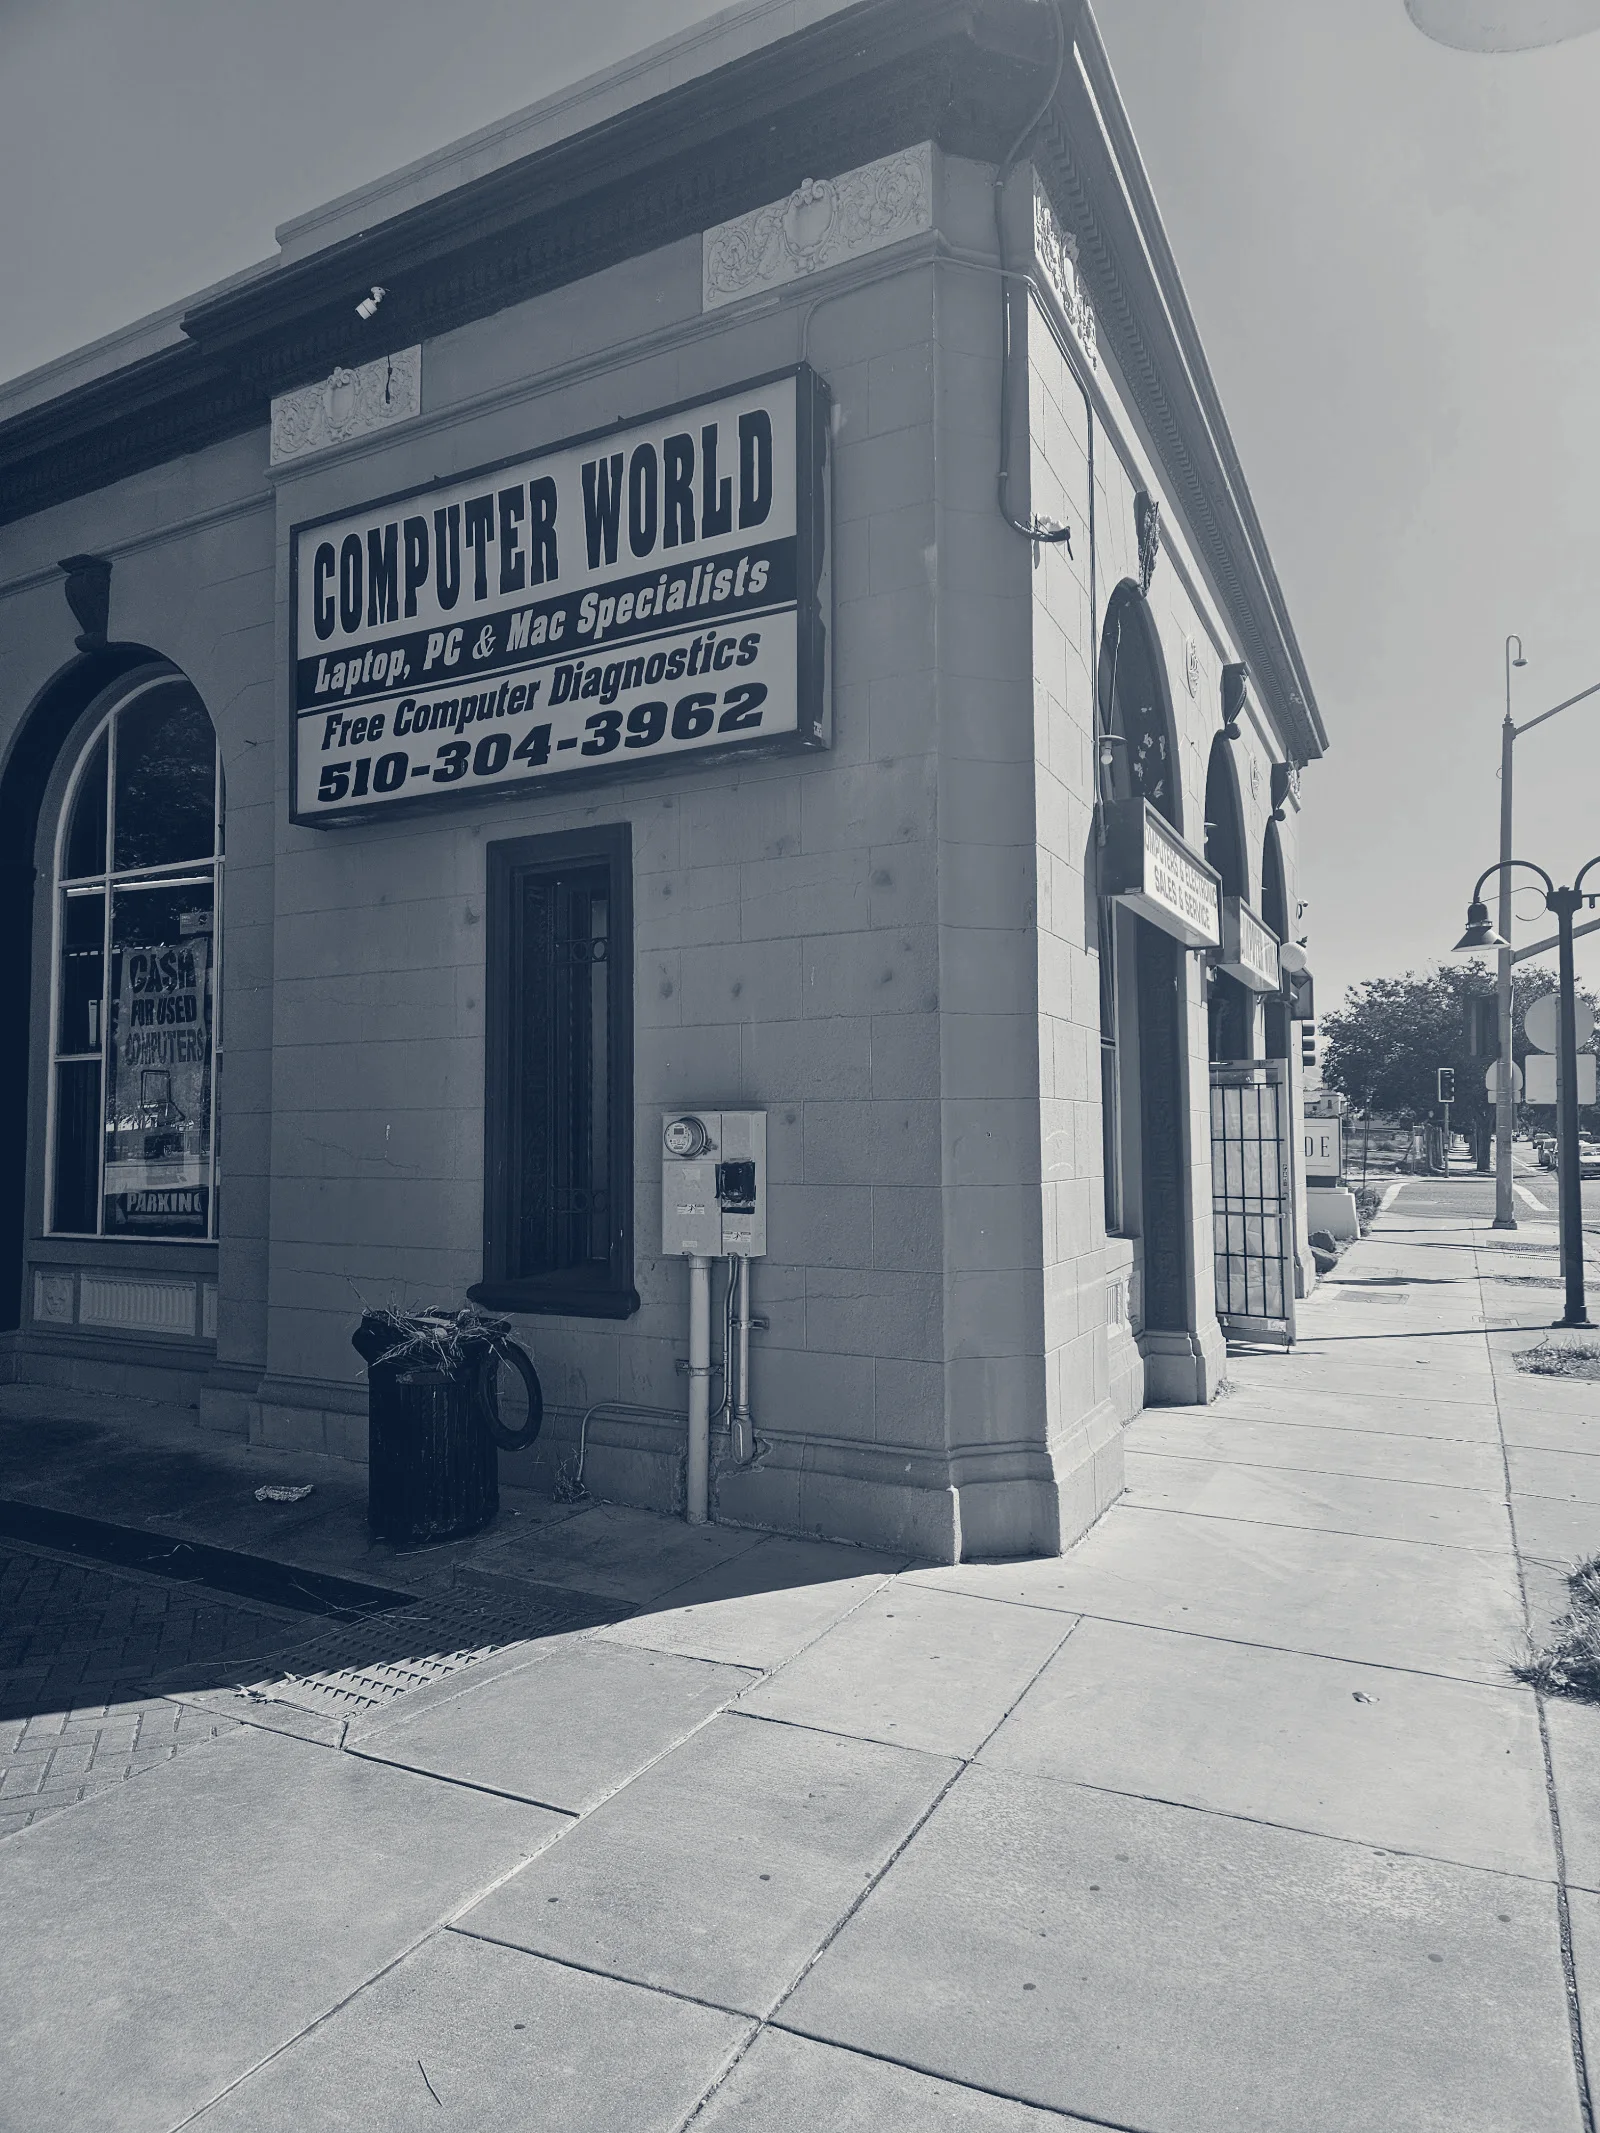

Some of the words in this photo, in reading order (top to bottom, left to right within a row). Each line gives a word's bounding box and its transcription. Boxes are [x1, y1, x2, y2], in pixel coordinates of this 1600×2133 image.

[313, 476, 559, 641] COMPUTER
[581, 408, 773, 571] WORLD
[314, 649, 410, 695] Laptop,
[424, 628, 463, 671] PC
[472, 625, 496, 660] &
[506, 608, 565, 652] Mac
[577, 556, 770, 638] Specialists
[321, 711, 383, 751] Free
[393, 680, 542, 738] Computer
[547, 632, 761, 706] Diagnostics
[317, 683, 769, 803] 510-304-3962
[1154, 864, 1177, 906] SALES
[1178, 885, 1184, 911] &
[1184, 890, 1211, 930] SERVICE
[129, 949, 197, 995] CASH
[156, 995, 198, 1026] USED
[124, 1028, 204, 1065] COMPUTERS
